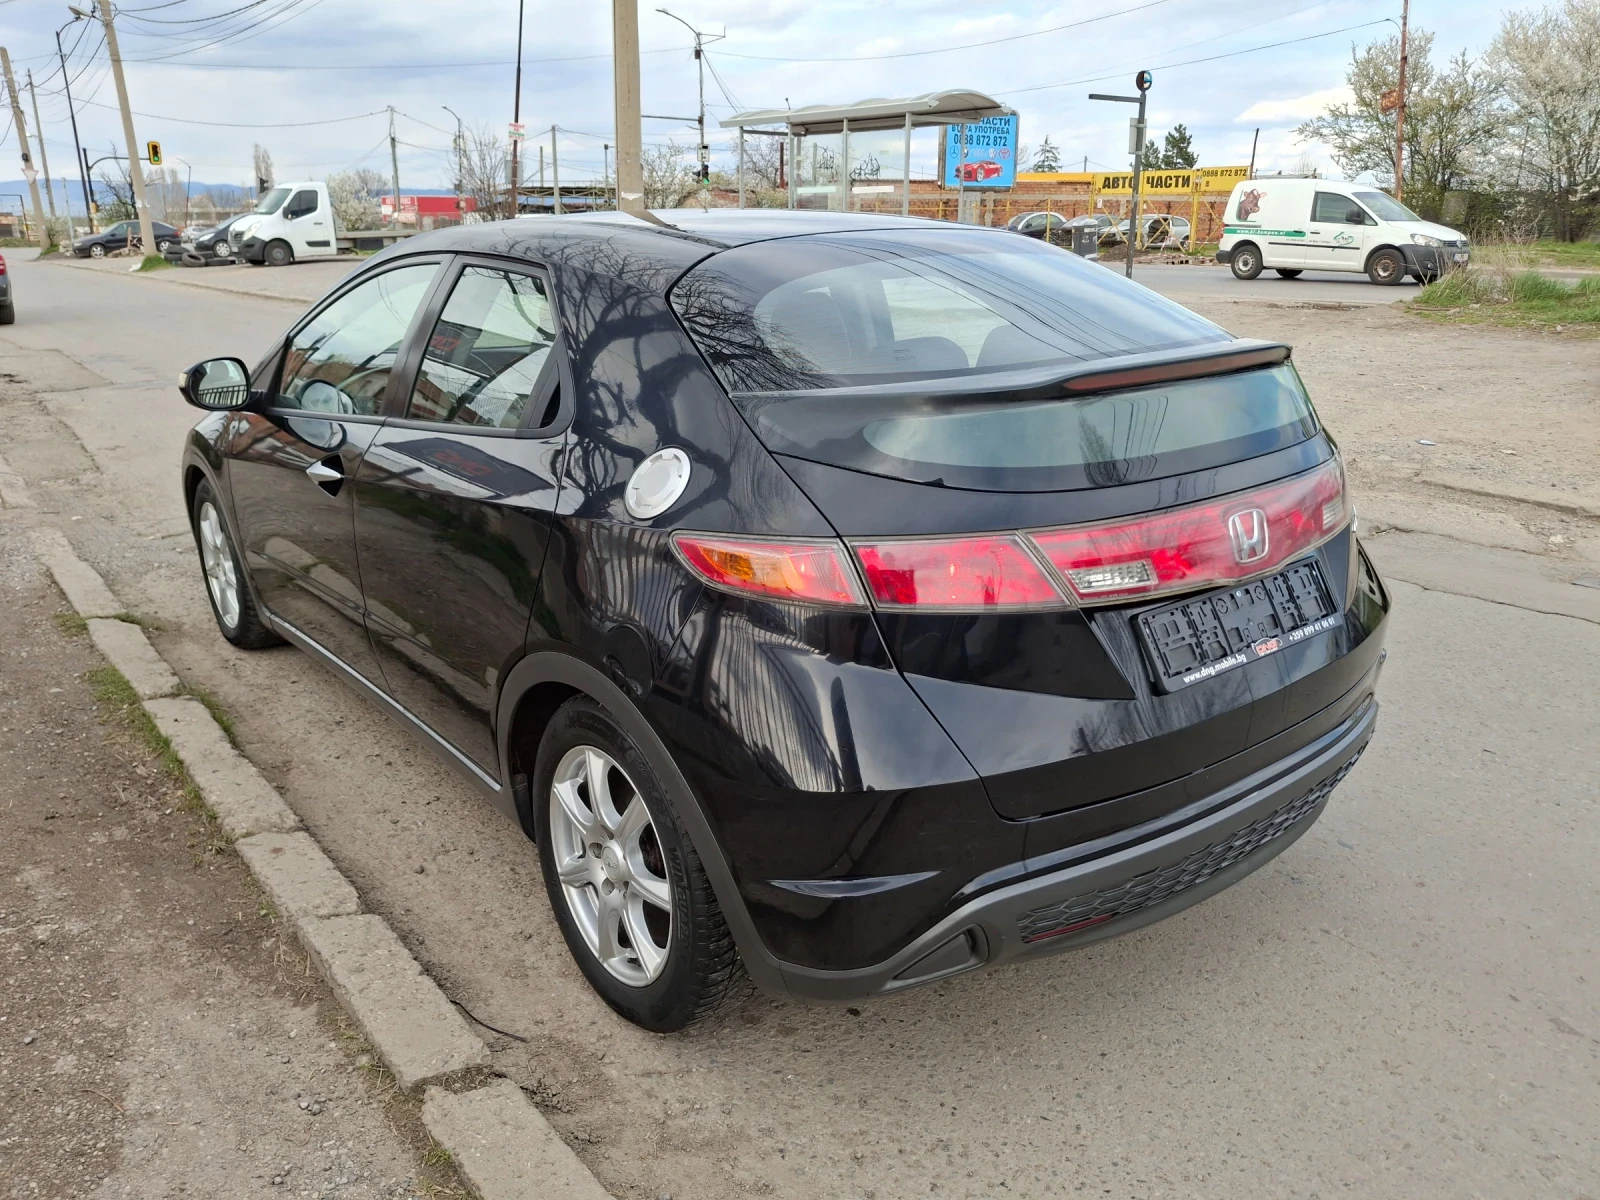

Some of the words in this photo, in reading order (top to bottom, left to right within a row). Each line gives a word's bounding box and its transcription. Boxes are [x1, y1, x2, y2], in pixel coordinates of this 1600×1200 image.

[974, 125, 1010, 135] УПОТРЕБА
[976, 134, 991, 146] 872
[992, 135, 1008, 147] 872
[1202, 169, 1219, 177] 0888
[1219, 168, 1233, 177] 872
[1234, 168, 1247, 177] 872
[1146, 174, 1191, 189] ЧАСТИ
[1289, 629, 1304, 641] +359
[1303, 625, 1315, 636] 899
[1315, 622, 1321, 631] 41
[1321, 619, 1329, 628] 06
[1328, 617, 1335, 625] 01
[1182, 653, 1247, 684] www.dng.mobile.bg
